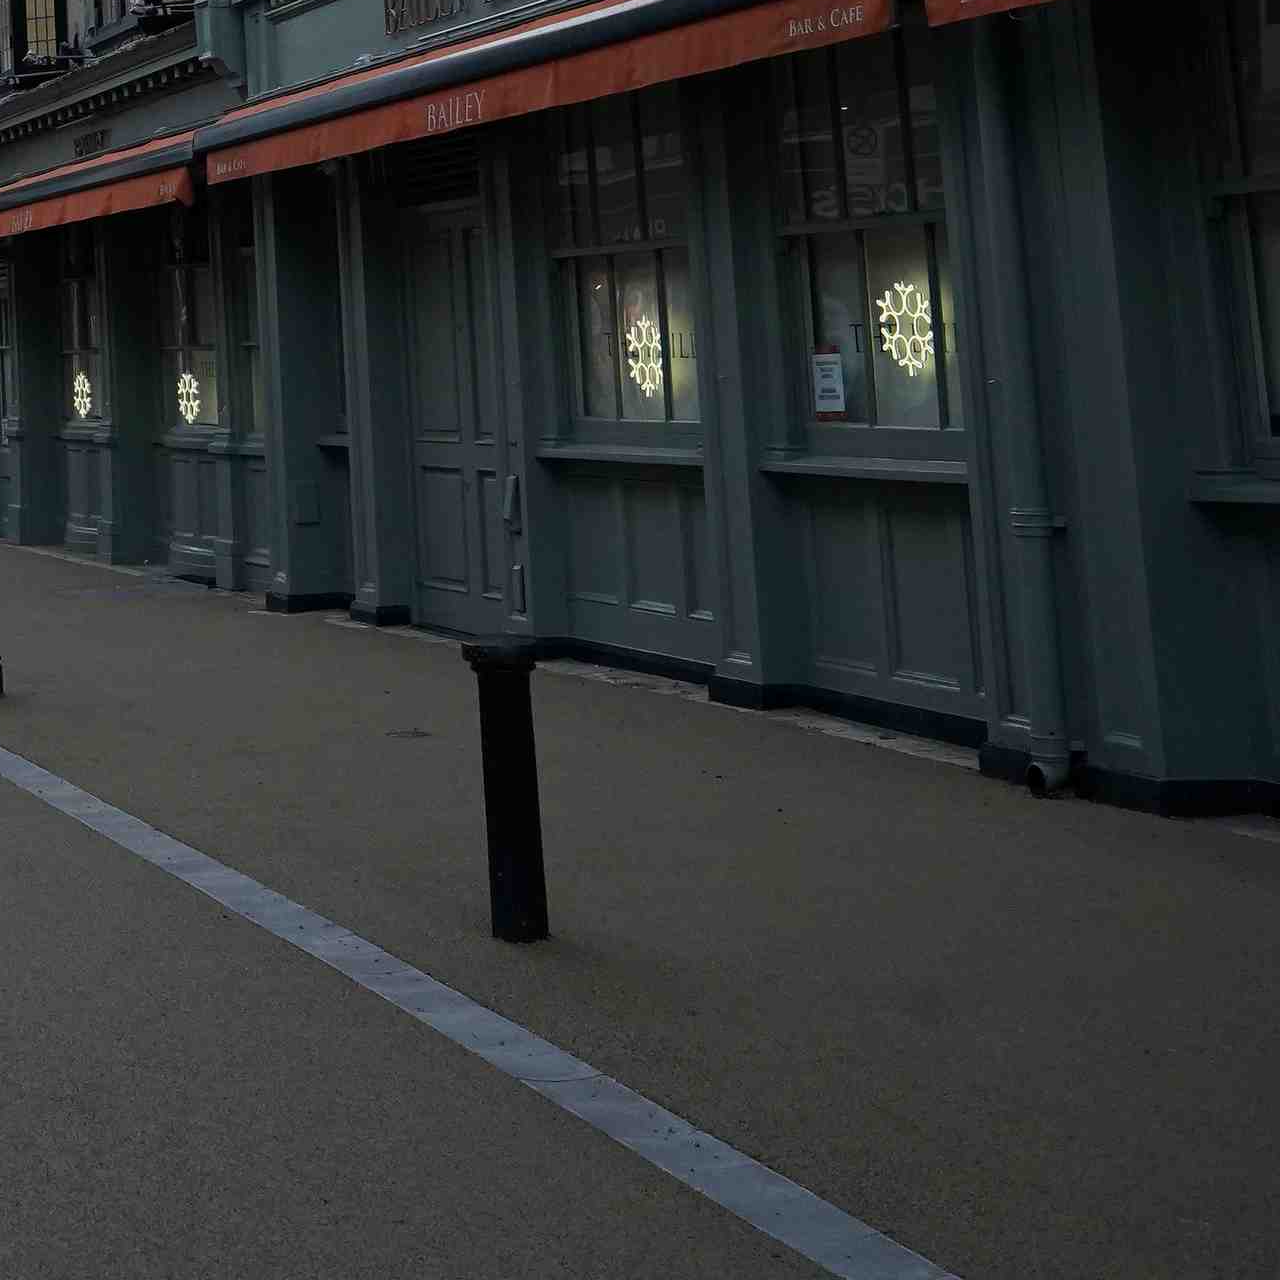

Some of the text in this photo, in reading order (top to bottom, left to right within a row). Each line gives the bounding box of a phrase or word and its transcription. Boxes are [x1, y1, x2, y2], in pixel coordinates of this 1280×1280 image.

[788, 19, 814, 37] BAR
[817, 15, 826, 32] &
[427, 88, 486, 132] BAILEY
